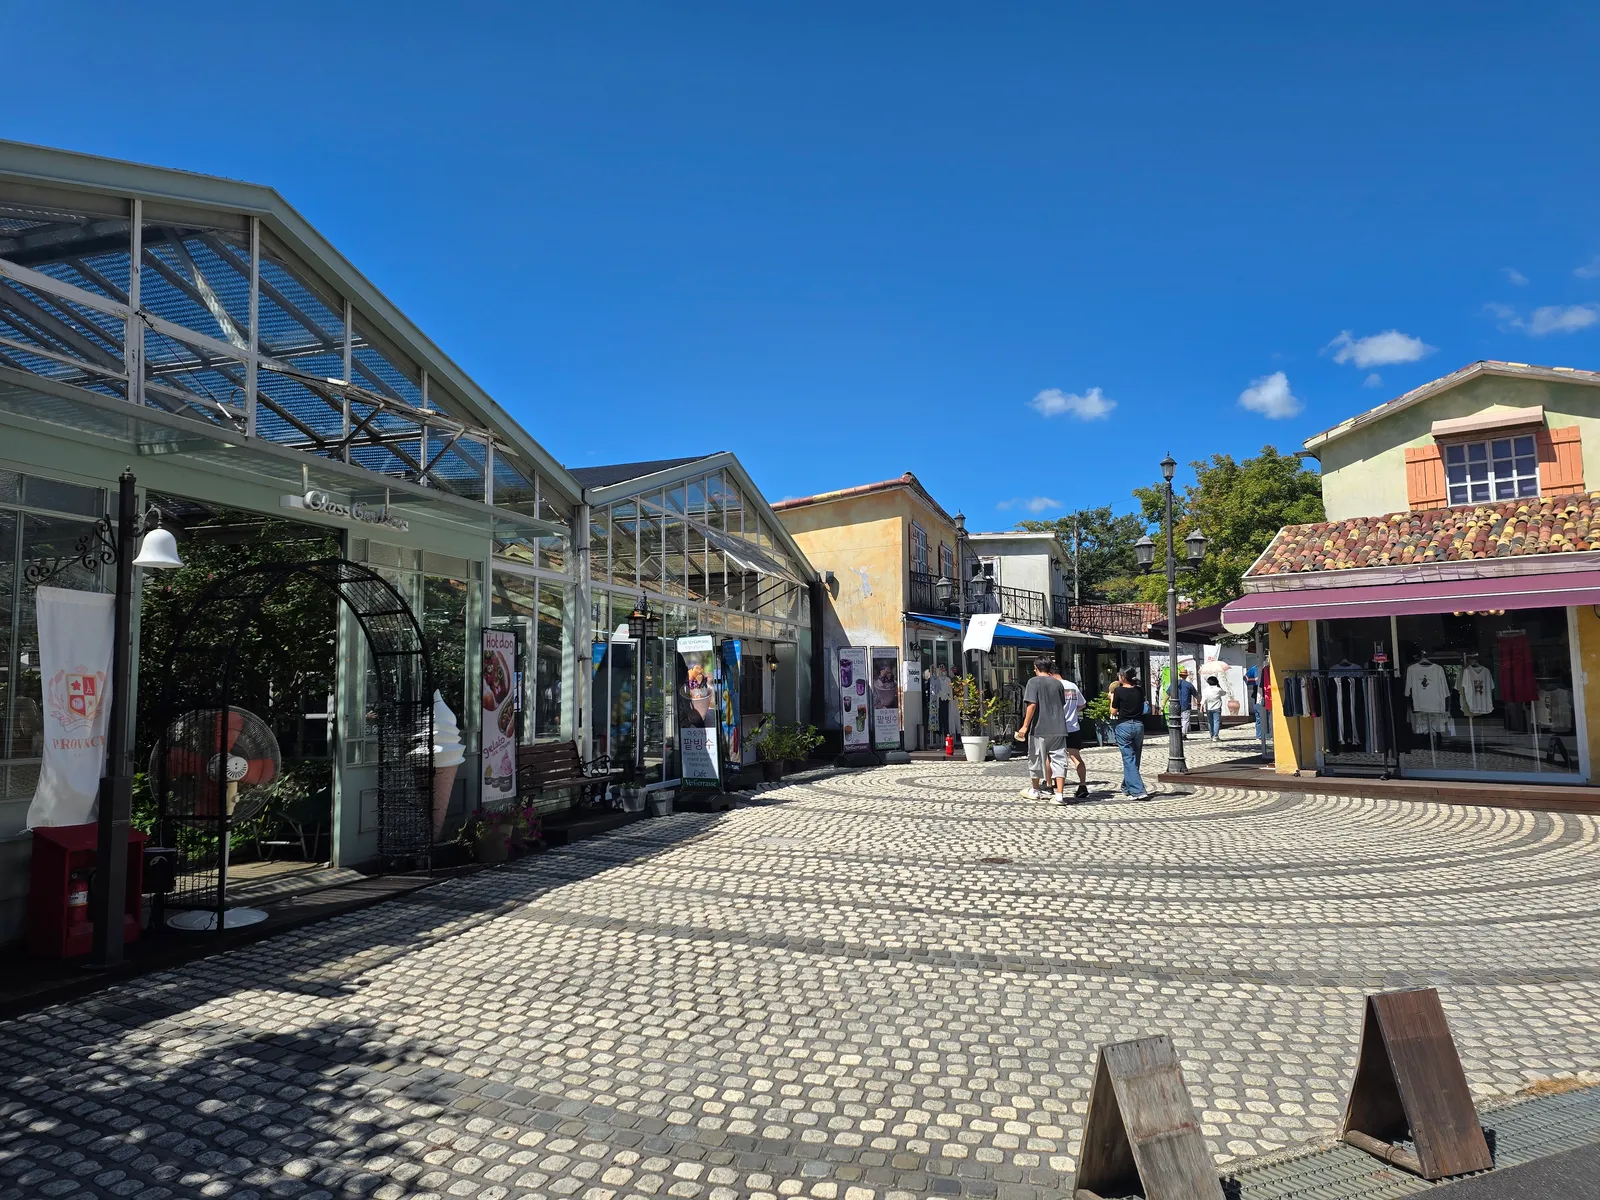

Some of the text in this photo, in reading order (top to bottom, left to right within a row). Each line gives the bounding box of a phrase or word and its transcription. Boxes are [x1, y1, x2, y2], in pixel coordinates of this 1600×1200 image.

[303, 490, 350, 516] Glass
[483, 736, 506, 759] gelato
[683, 738, 714, 751] 팥빙수
[693, 769, 707, 777] Cafe
